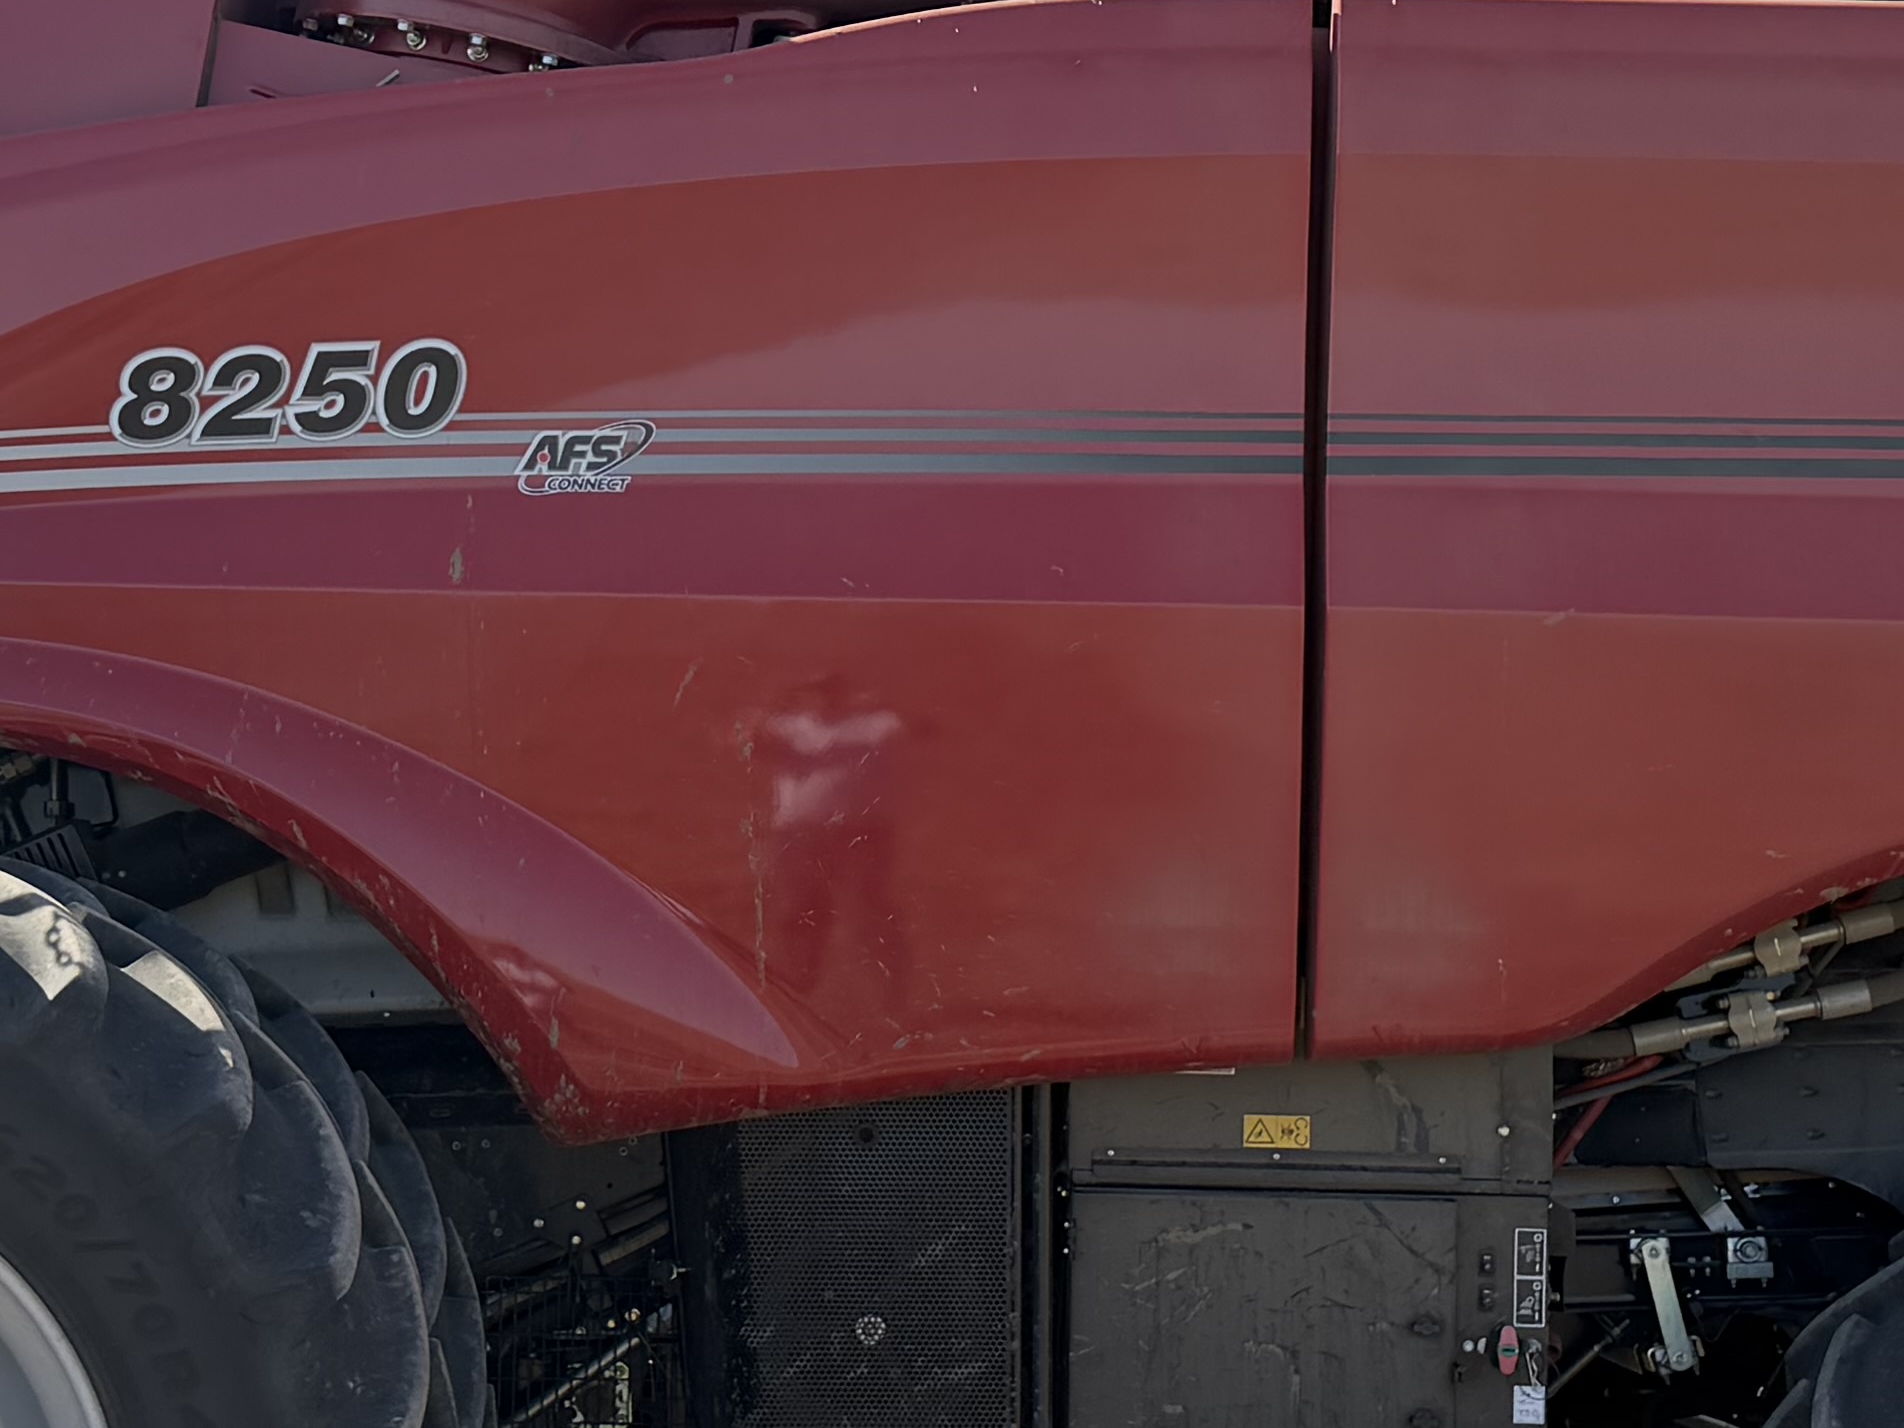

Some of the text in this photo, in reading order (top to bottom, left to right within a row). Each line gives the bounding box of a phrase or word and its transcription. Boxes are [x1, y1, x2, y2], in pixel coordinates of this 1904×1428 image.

[109, 337, 467, 447] 8250
[515, 429, 626, 474] AFS
[545, 475, 632, 493] CONNECT
